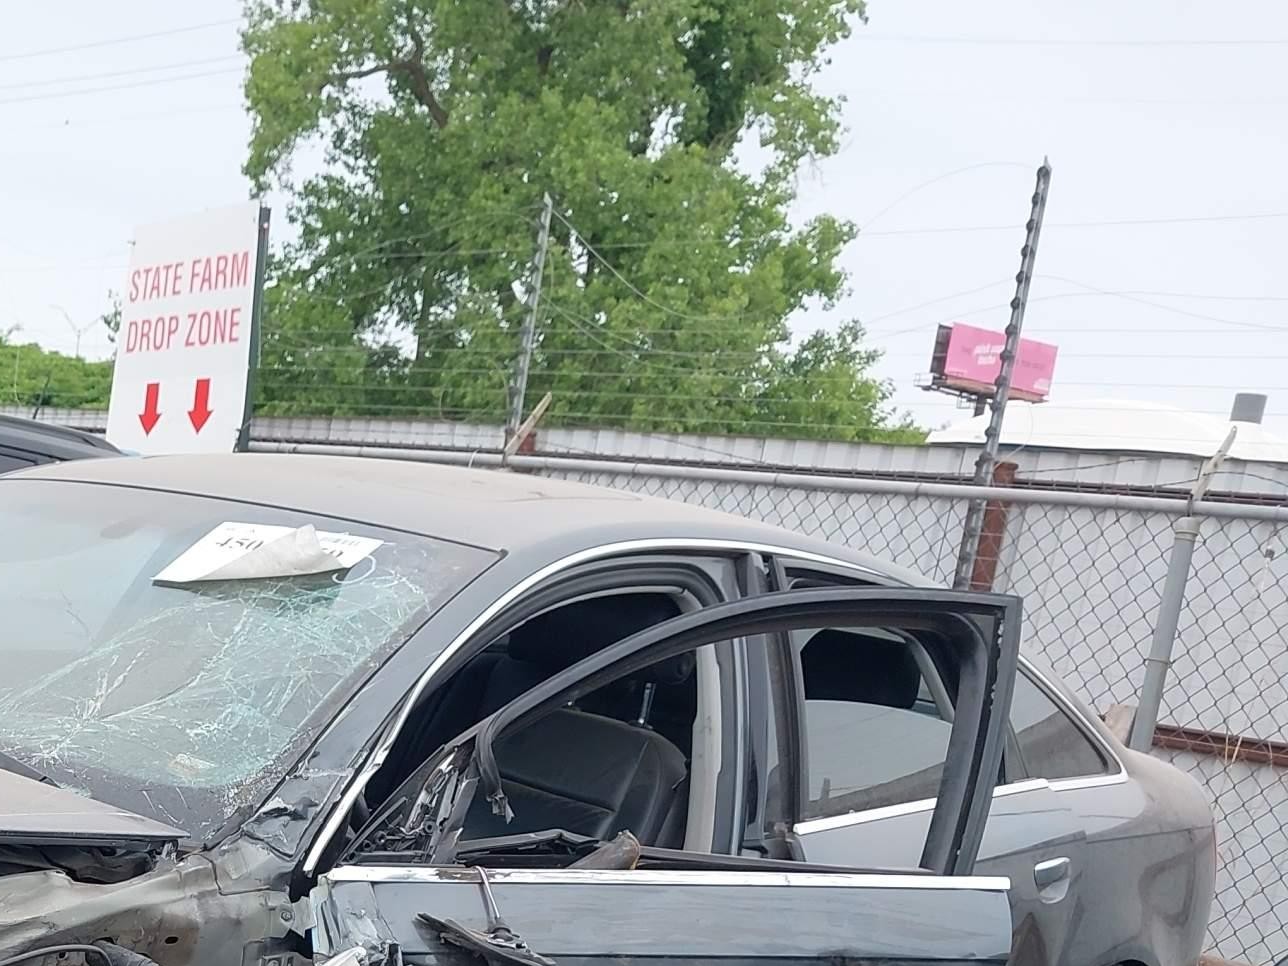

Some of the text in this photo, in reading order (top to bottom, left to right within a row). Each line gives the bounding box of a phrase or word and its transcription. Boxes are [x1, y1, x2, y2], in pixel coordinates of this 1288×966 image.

[129, 251, 250, 303] STATE FARM
[126, 308, 242, 354] DROP ZONE
